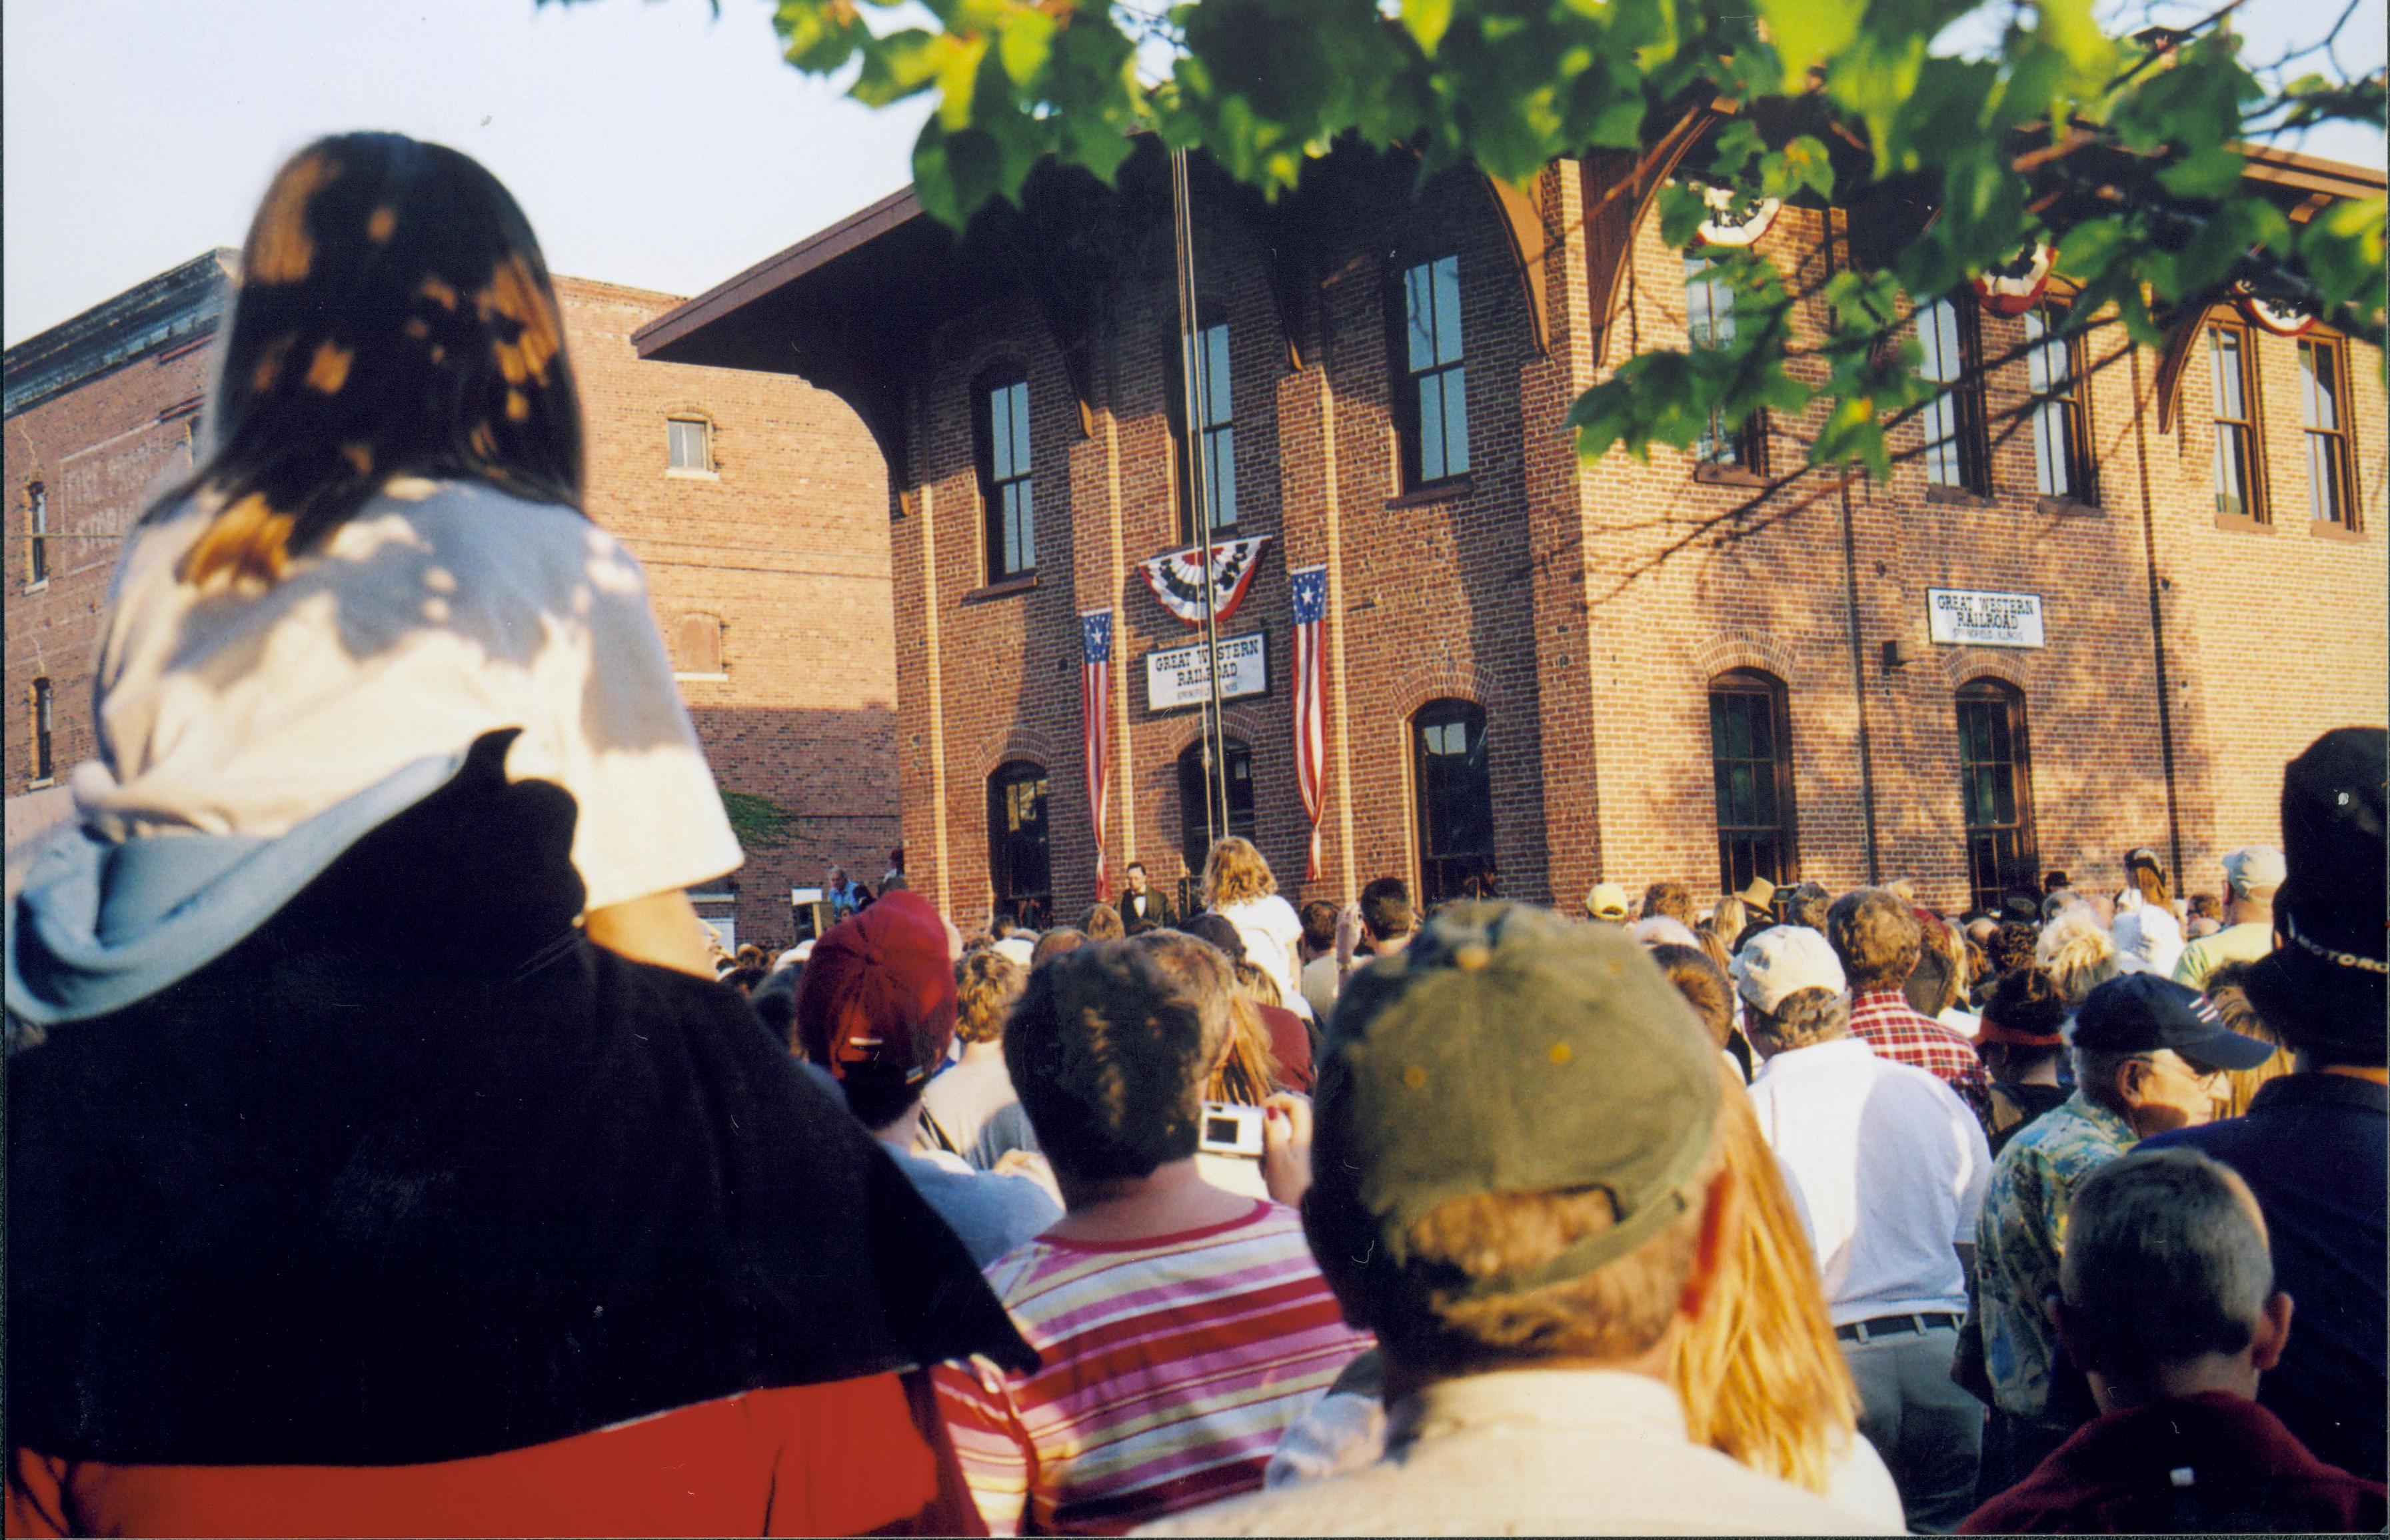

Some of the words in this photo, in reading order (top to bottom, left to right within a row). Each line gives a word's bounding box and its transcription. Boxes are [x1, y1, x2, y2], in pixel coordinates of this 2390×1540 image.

[1937, 595, 1972, 611] GREAT
[1979, 597, 2033, 614] WESTERN
[1957, 612, 2018, 629] RAILROAD
[1156, 651, 1191, 672] GREAT
[1197, 639, 1259, 663] WSTERN
